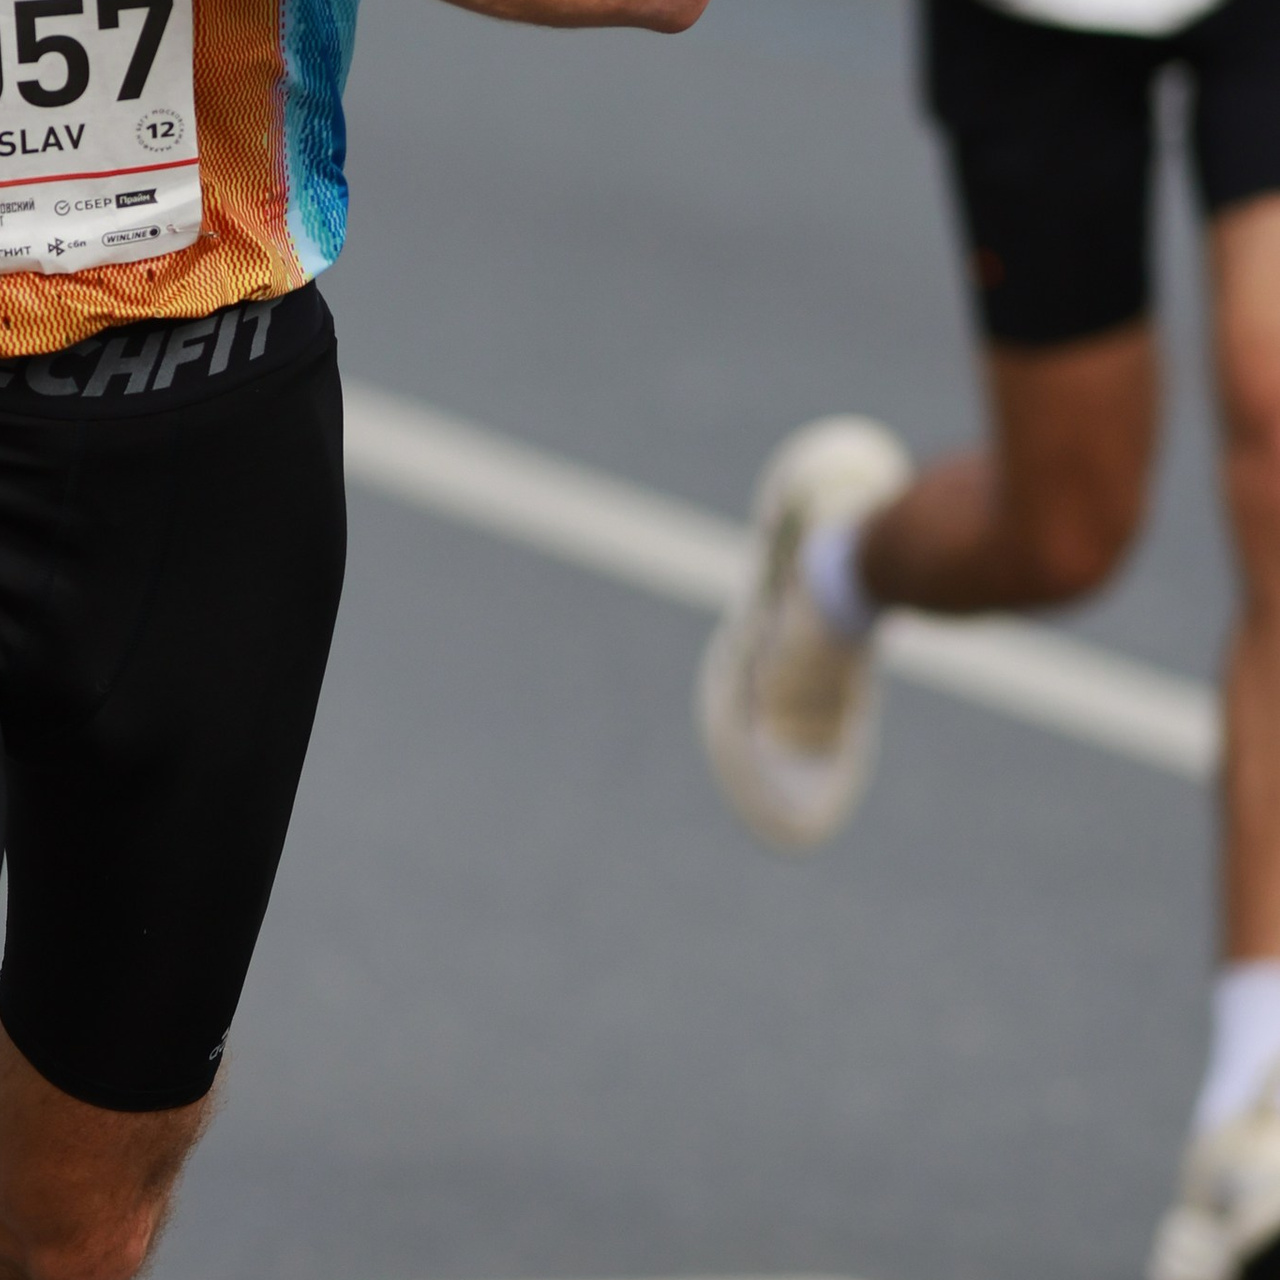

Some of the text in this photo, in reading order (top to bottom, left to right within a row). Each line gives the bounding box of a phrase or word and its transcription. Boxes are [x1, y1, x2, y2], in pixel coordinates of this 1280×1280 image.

[146, 121, 175, 139] 12
[74, 193, 151, 211] СБЕР Прайм
[106, 230, 148, 243] WINLINE
